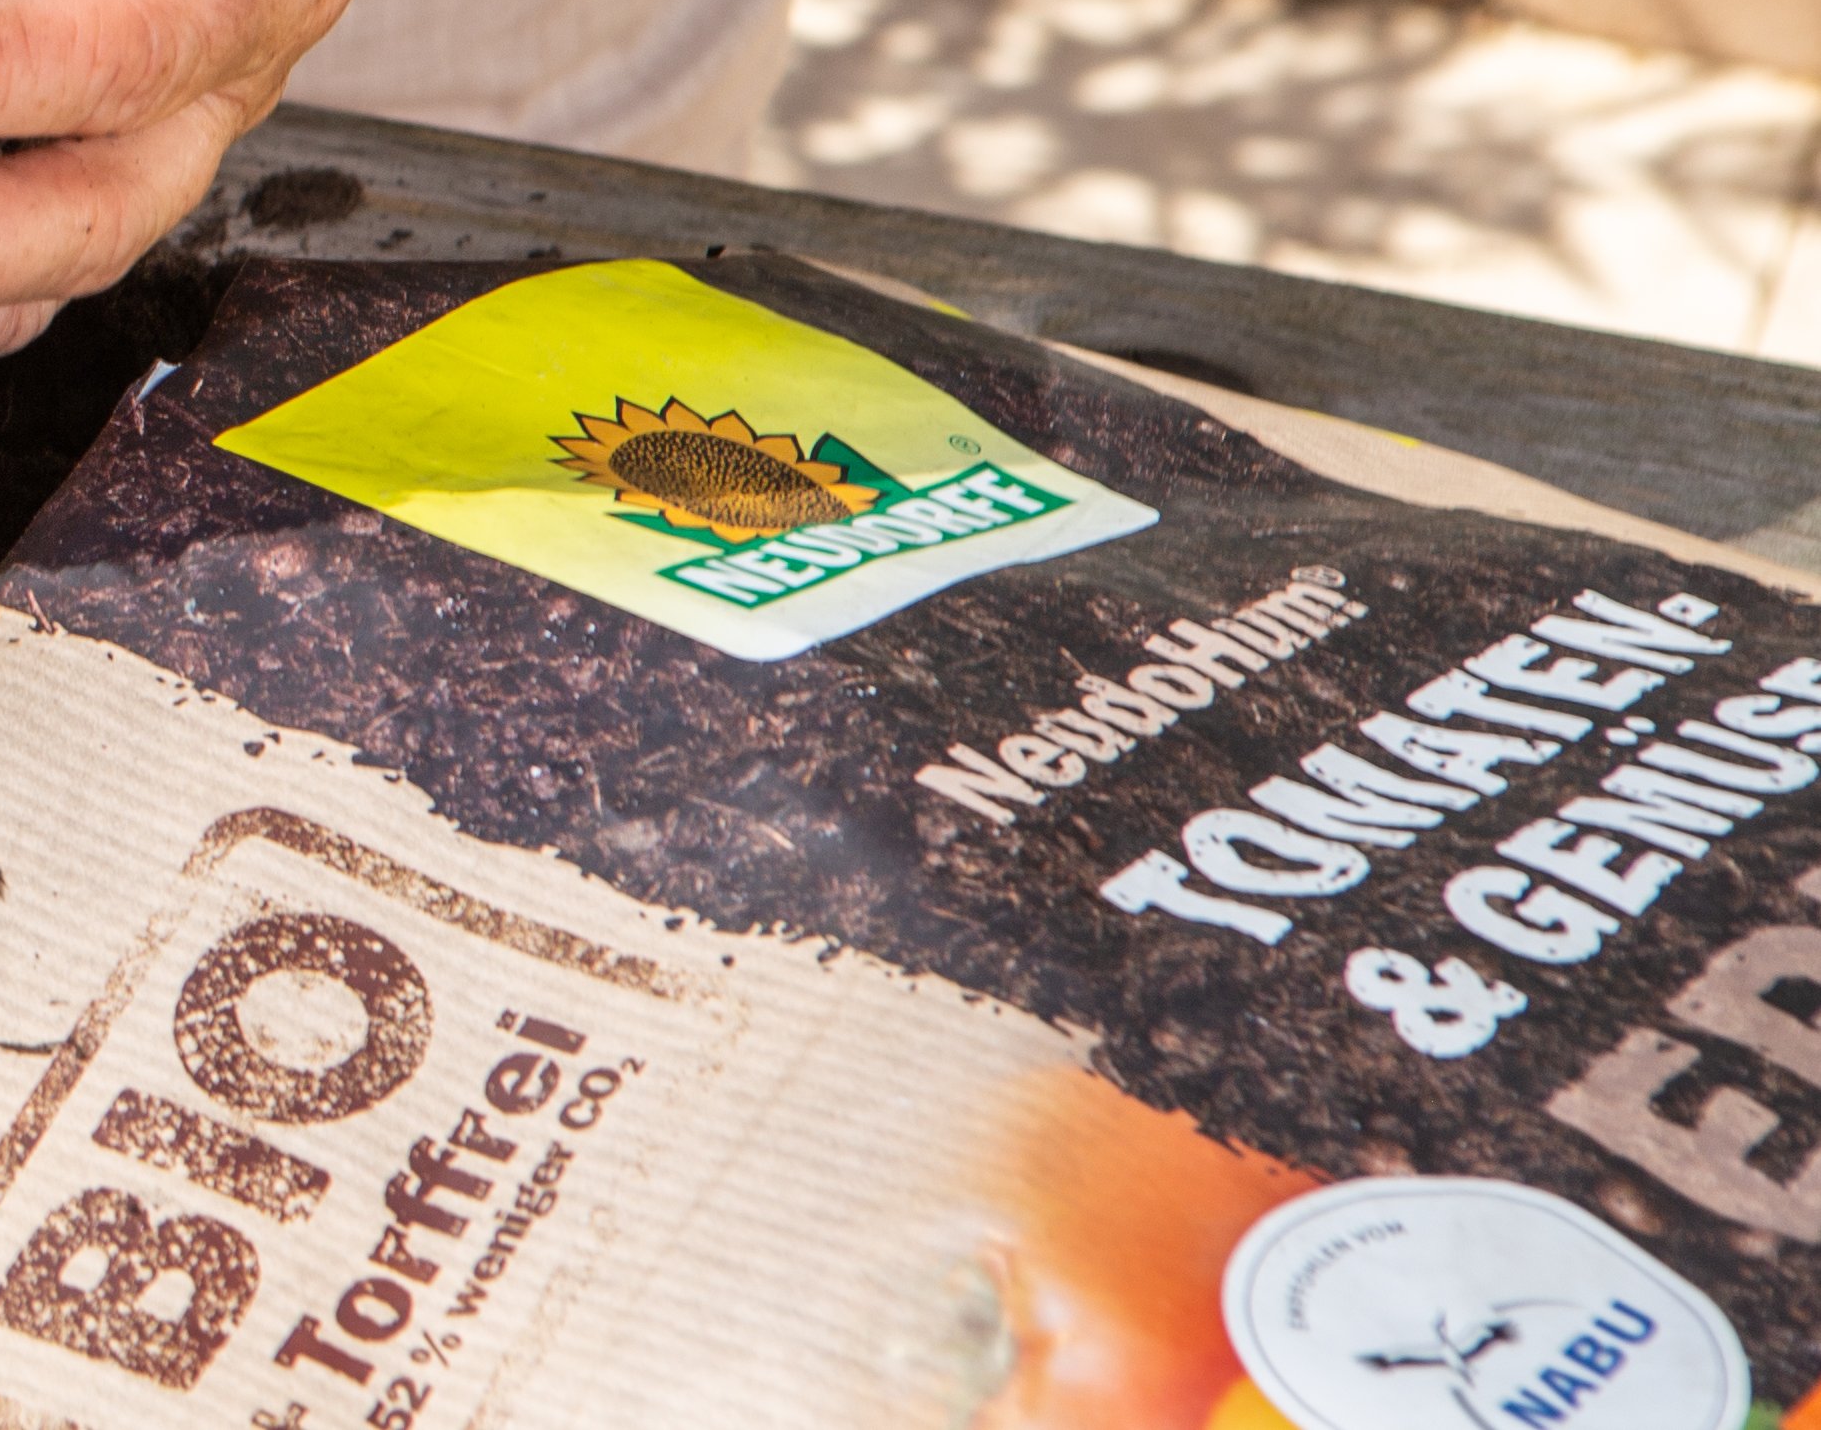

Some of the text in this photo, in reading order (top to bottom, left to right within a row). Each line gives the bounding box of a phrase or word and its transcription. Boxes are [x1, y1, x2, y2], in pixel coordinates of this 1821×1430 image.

[675, 467, 1046, 606] NEUDORFF
[1344, 947, 1529, 1059] &
[273, 1008, 588, 1387] Torffrei
[409, 1330, 463, 1368] %
[446, 1140, 575, 1319] weniger
[1500, 1298, 1662, 1430] NABU
